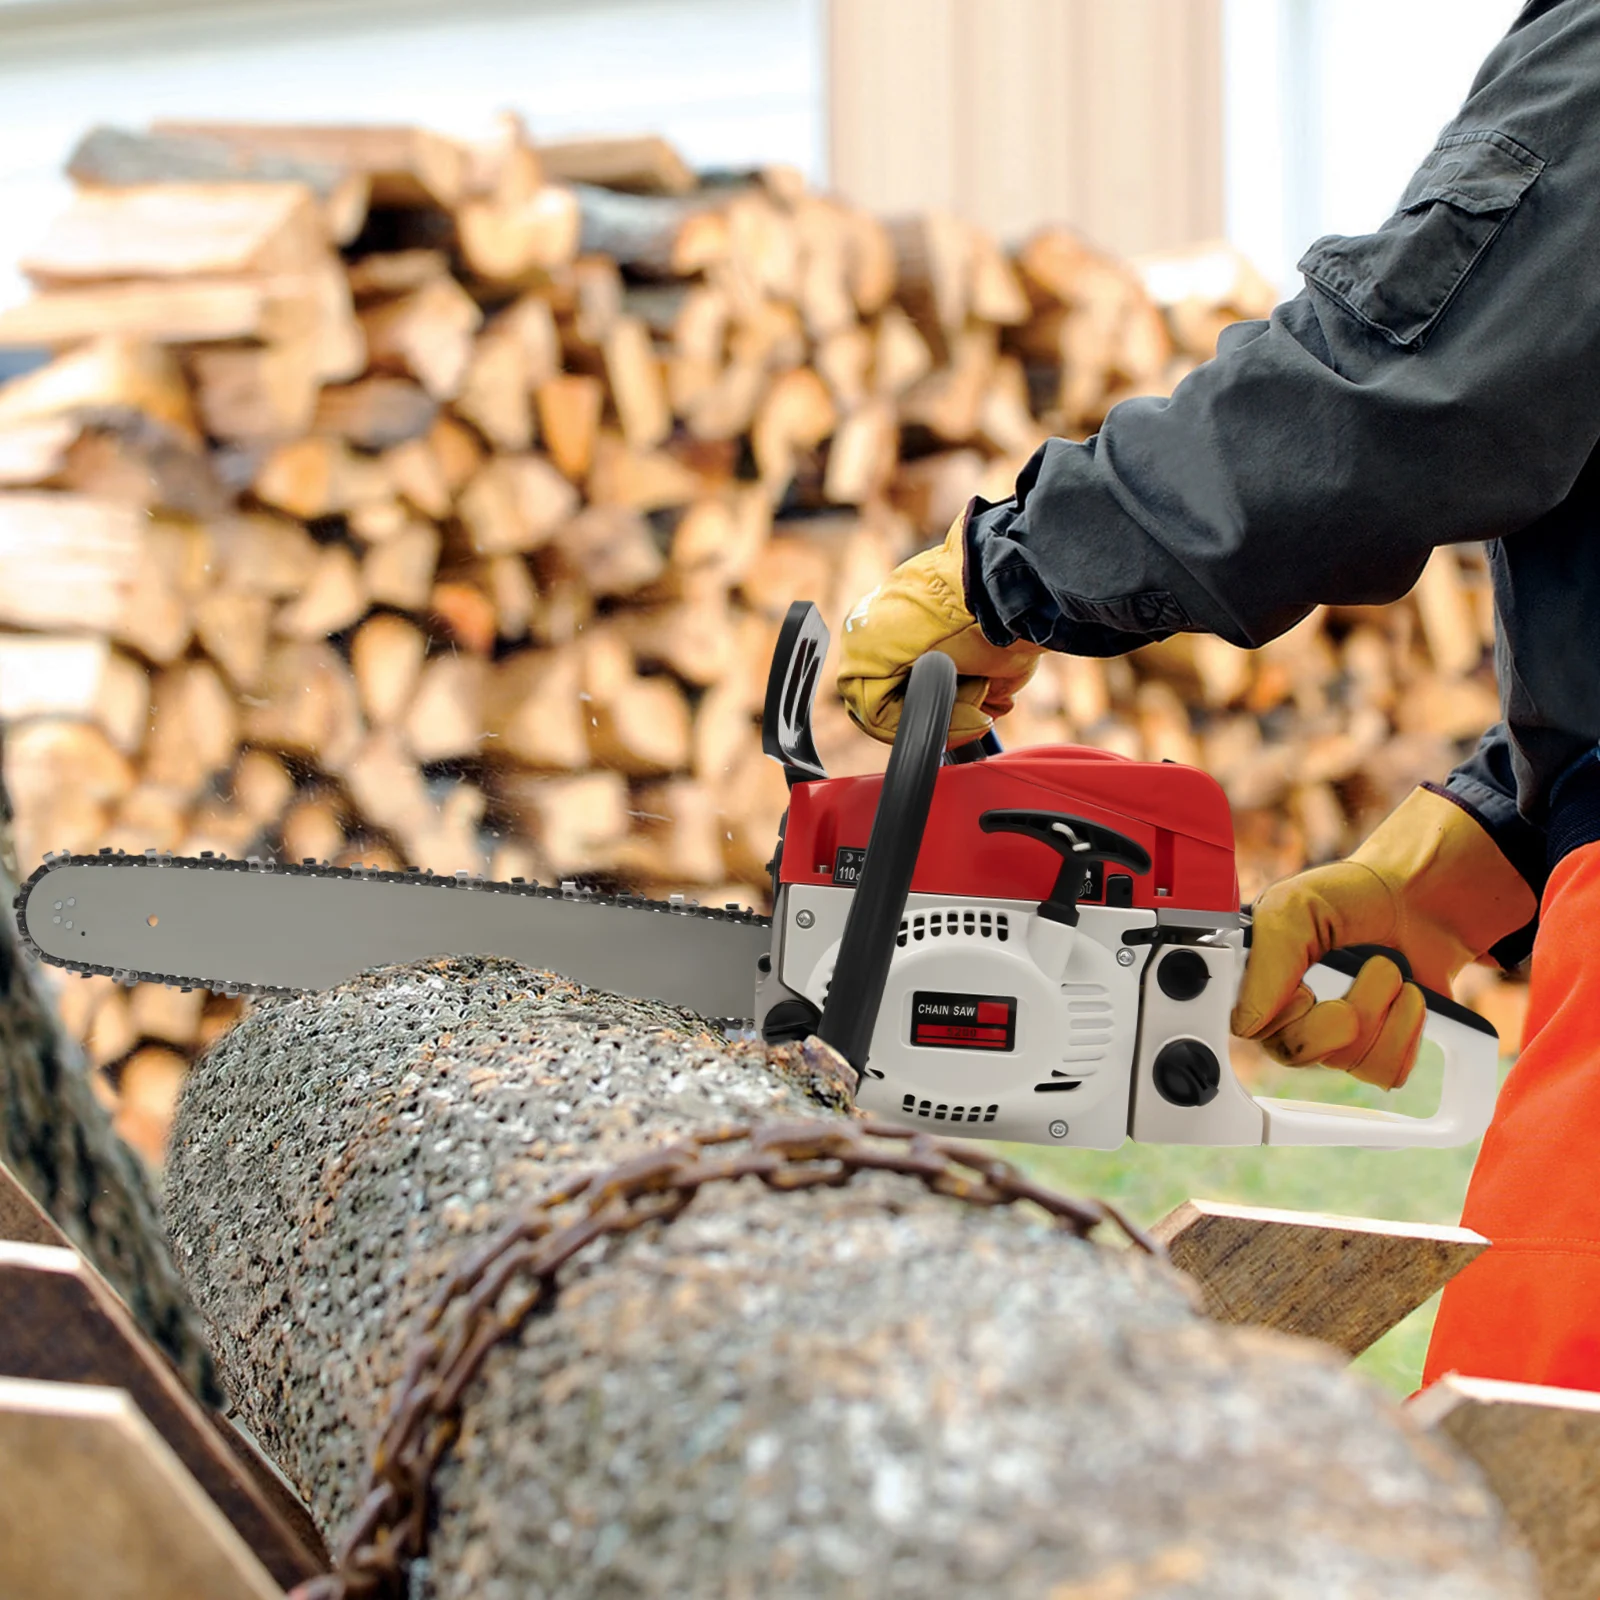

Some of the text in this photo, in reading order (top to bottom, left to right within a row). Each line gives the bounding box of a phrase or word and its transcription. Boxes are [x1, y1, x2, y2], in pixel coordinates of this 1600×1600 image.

[839, 866, 856, 880] 110
[918, 1003, 976, 1017] CHAIN SAW
